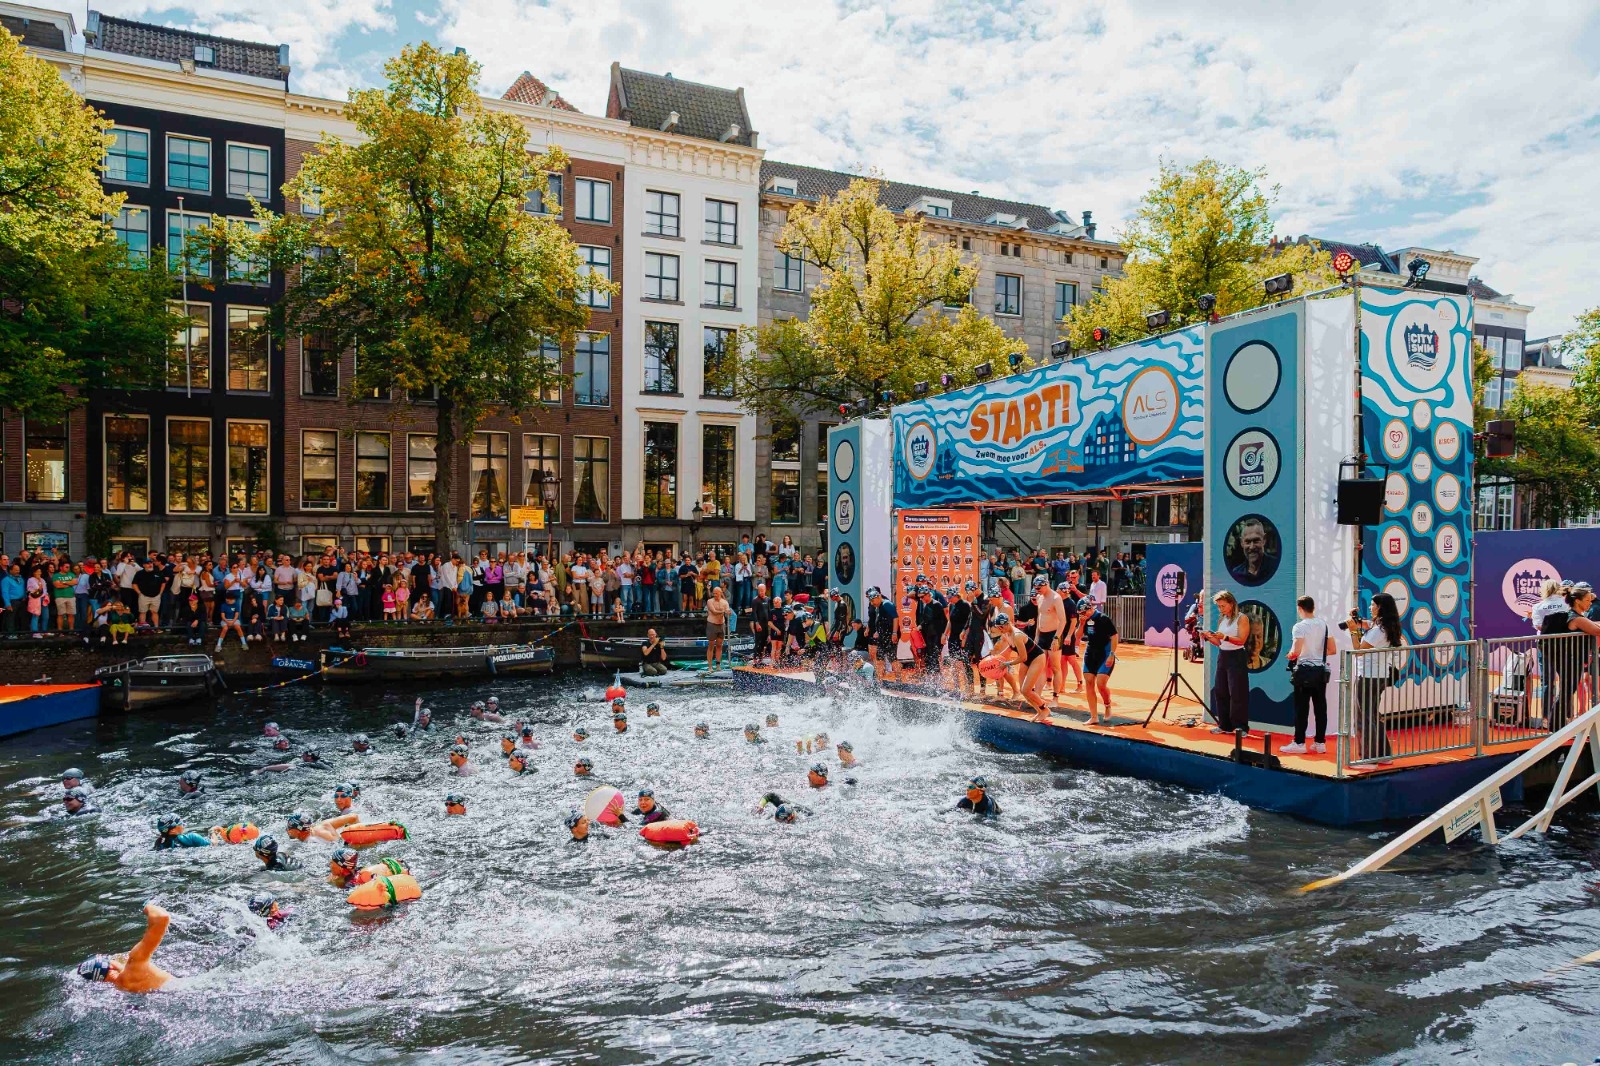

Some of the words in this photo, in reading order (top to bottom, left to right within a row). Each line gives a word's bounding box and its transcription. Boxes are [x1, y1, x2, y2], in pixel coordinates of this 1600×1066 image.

[1410, 333, 1433, 344] CITY
[1411, 344, 1435, 353] SWIM
[1132, 390, 1168, 415] ALS
[969, 384, 1071, 445] START!
[975, 450, 996, 459] Zwem
[996, 454, 1011, 463] mee
[1011, 451, 1029, 462] voor
[1029, 440, 1047, 456] ALS.
[1240, 476, 1263, 485] CSDM
[730, 643, 756, 651] MOKUMB
[492, 651, 535, 663] MOKUMBOOT
